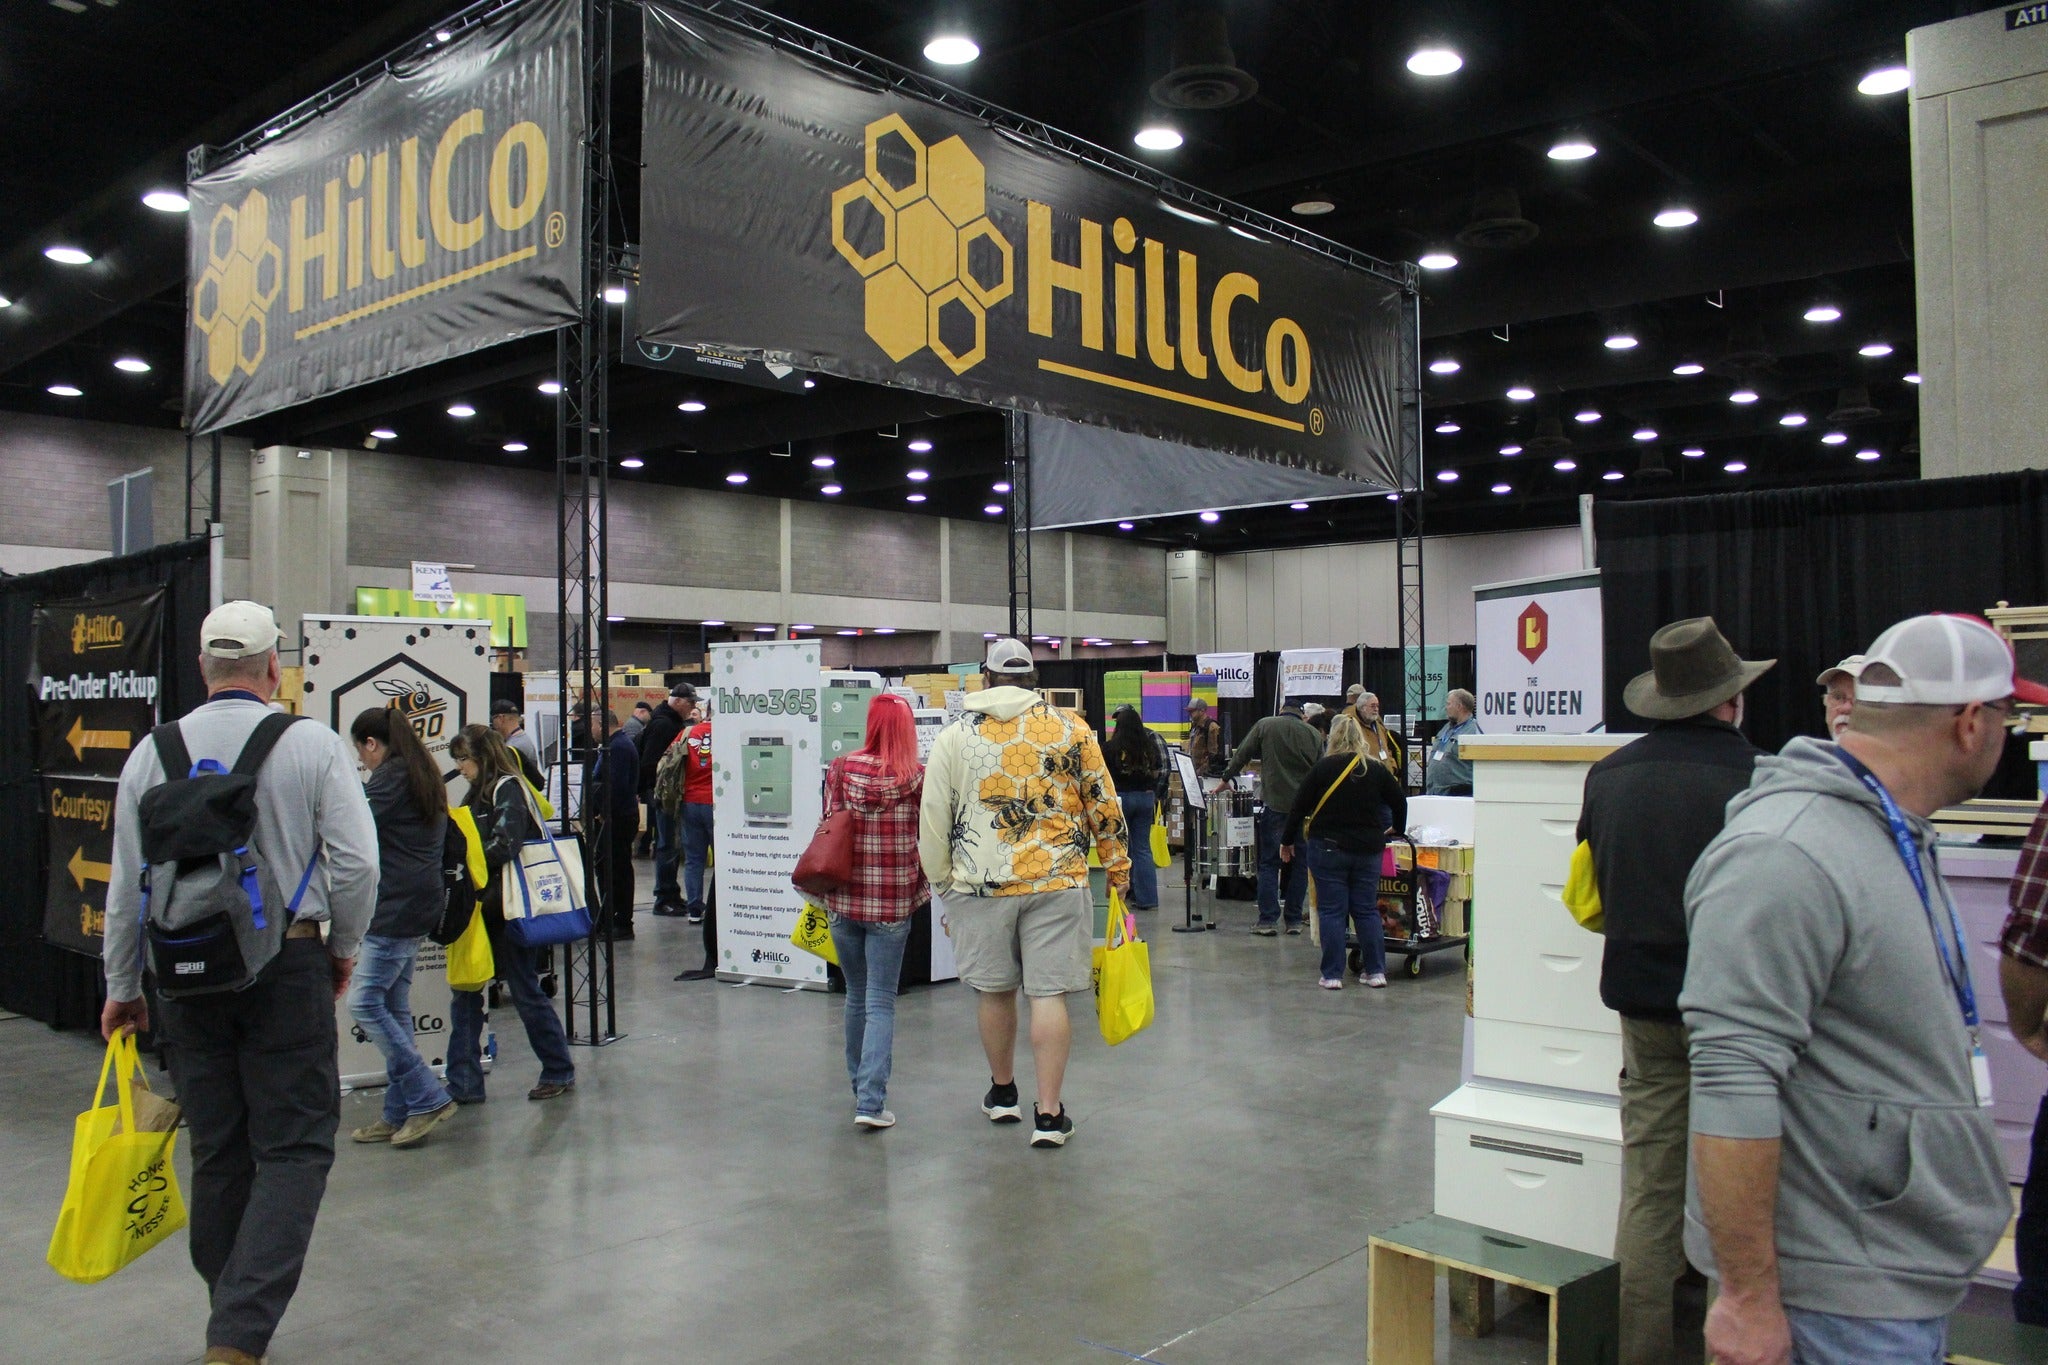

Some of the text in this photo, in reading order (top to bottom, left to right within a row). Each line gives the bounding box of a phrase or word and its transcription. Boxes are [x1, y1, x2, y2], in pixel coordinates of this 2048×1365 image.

[289, 108, 549, 313] HillCo
[1027, 199, 1312, 405] HillCo
[87, 614, 124, 643] HillCo
[1215, 667, 1250, 680] HillCo
[1285, 663, 1338, 674] SPEED FILL
[1409, 672, 1443, 682] hiv365
[40, 669, 158, 705] Pre-Order Pickup
[1527, 676, 1538, 687] THE
[718, 686, 818, 716] hive365
[1484, 690, 1582, 718] ONE QUEEN
[51, 787, 112, 832] Courtesy
[731, 850, 747, 858] Ready
[755, 851, 769, 859] bees,
[769, 852, 782, 860] right
[731, 867, 750, 875] Built-in
[733, 928, 756, 937] Fabulous
[756, 930, 776, 939] 10-year
[763, 951, 790, 963] HillCo
[127, 1158, 166, 1193] HONE
